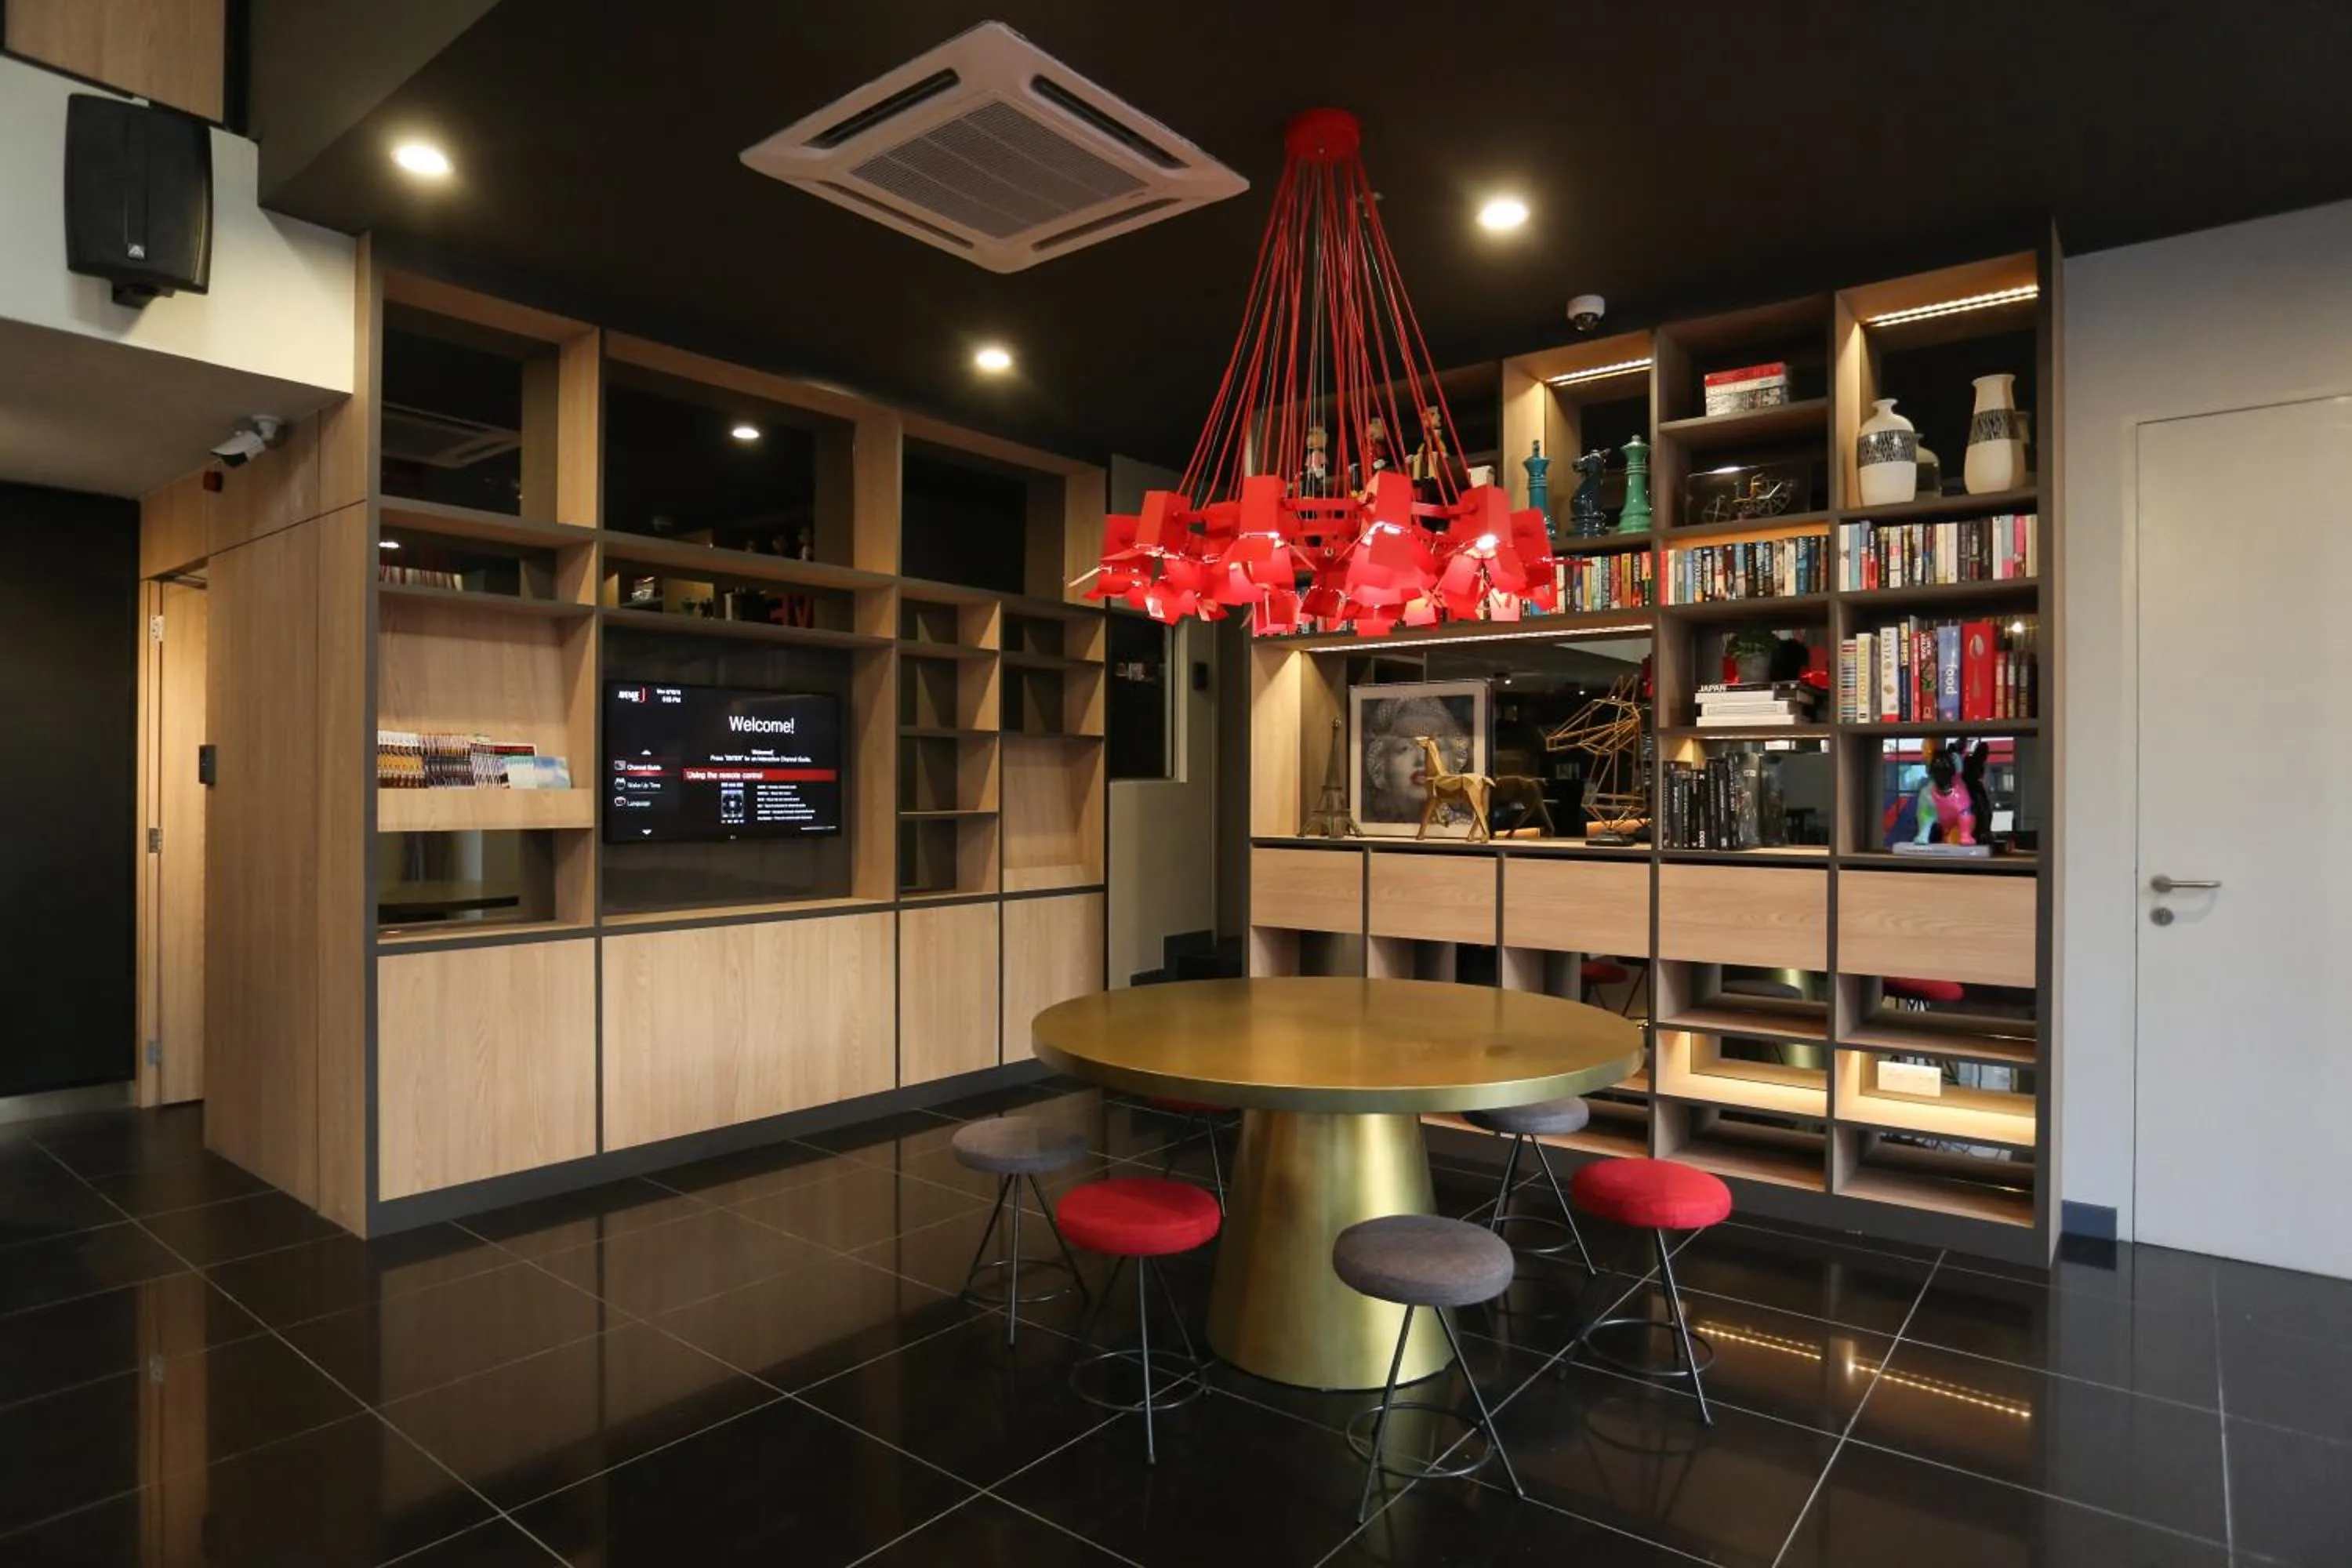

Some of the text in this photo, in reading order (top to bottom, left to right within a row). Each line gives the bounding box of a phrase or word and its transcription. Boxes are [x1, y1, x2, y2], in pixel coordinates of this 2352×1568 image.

[1883, 630, 1893, 661] PASTA
[1944, 664, 1958, 695] food
[728, 715, 794, 734] Welcome!
[686, 771, 706, 780] Using
